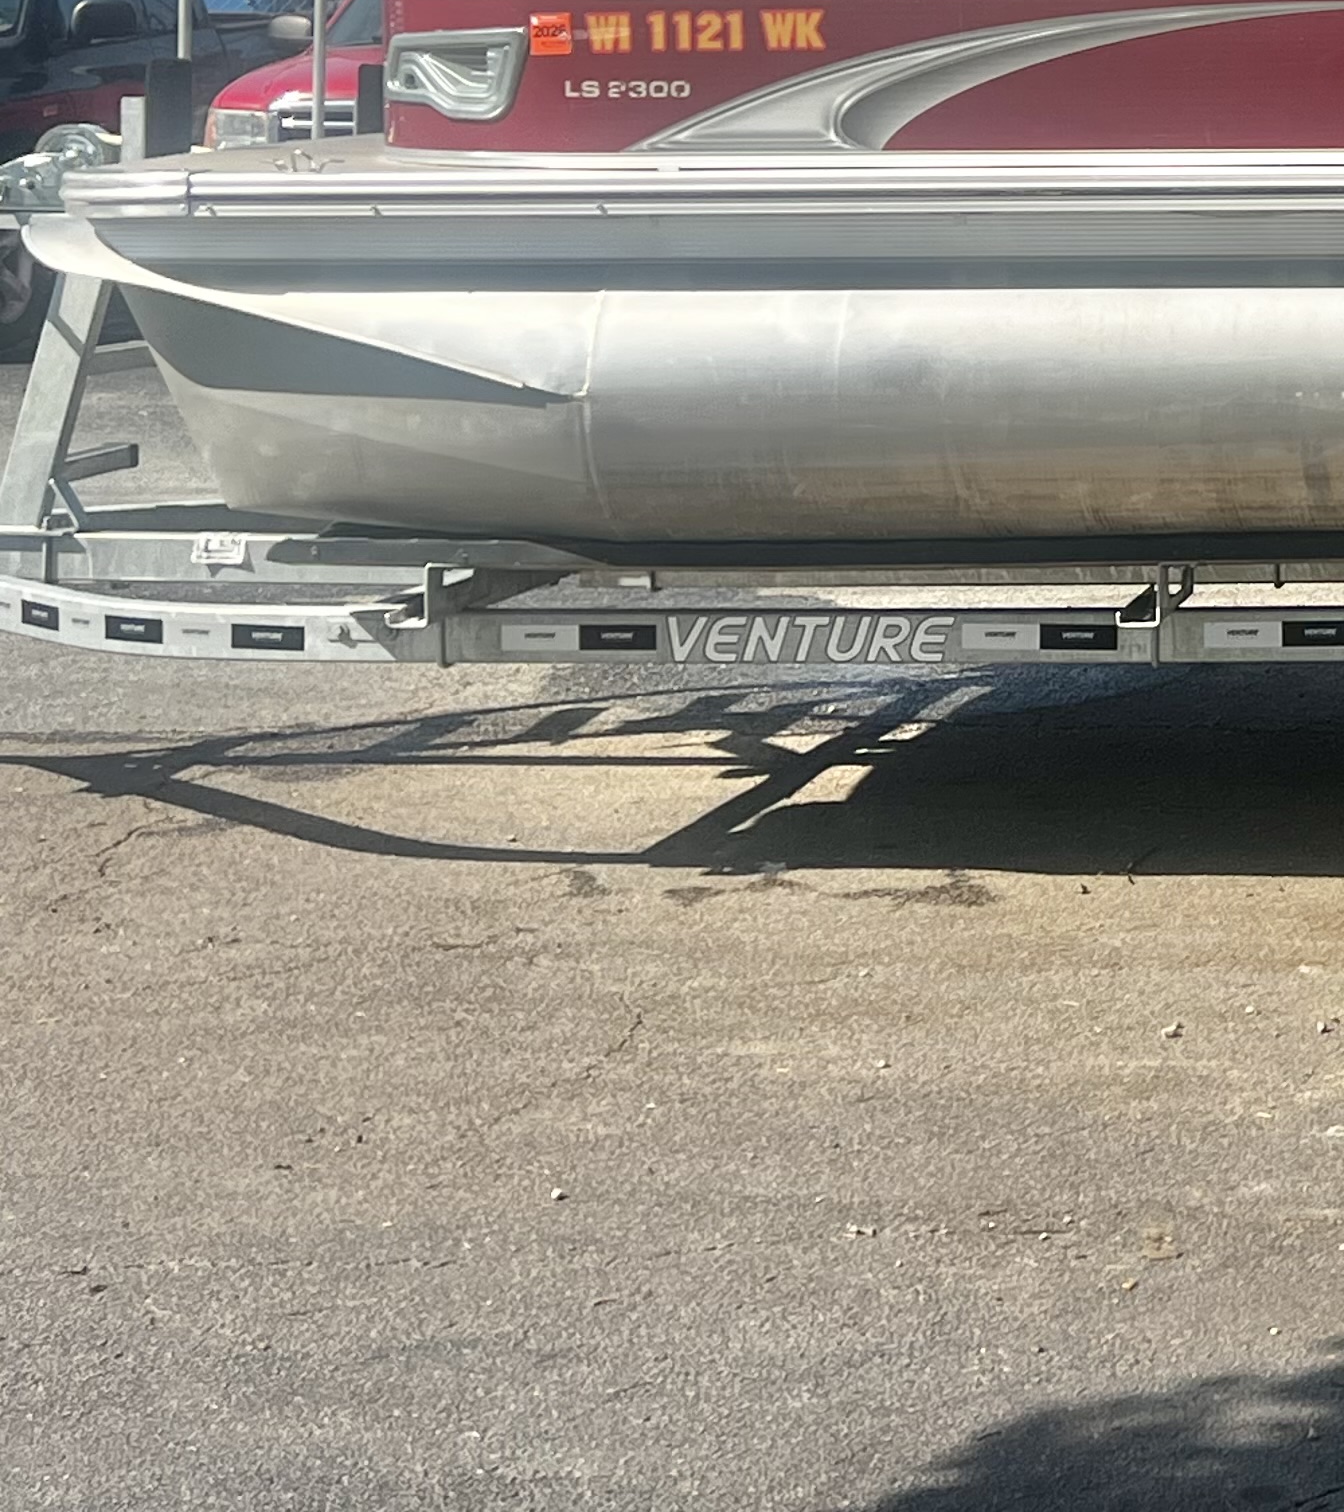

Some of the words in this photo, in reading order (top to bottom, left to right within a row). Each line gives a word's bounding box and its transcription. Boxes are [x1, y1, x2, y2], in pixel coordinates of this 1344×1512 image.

[584, 12, 633, 54] WI
[646, 10, 745, 52] 1121
[759, 9, 826, 52] WK
[565, 80, 600, 98] LS
[608, 80, 691, 98] 2300
[666, 616, 956, 663] VENTURE
